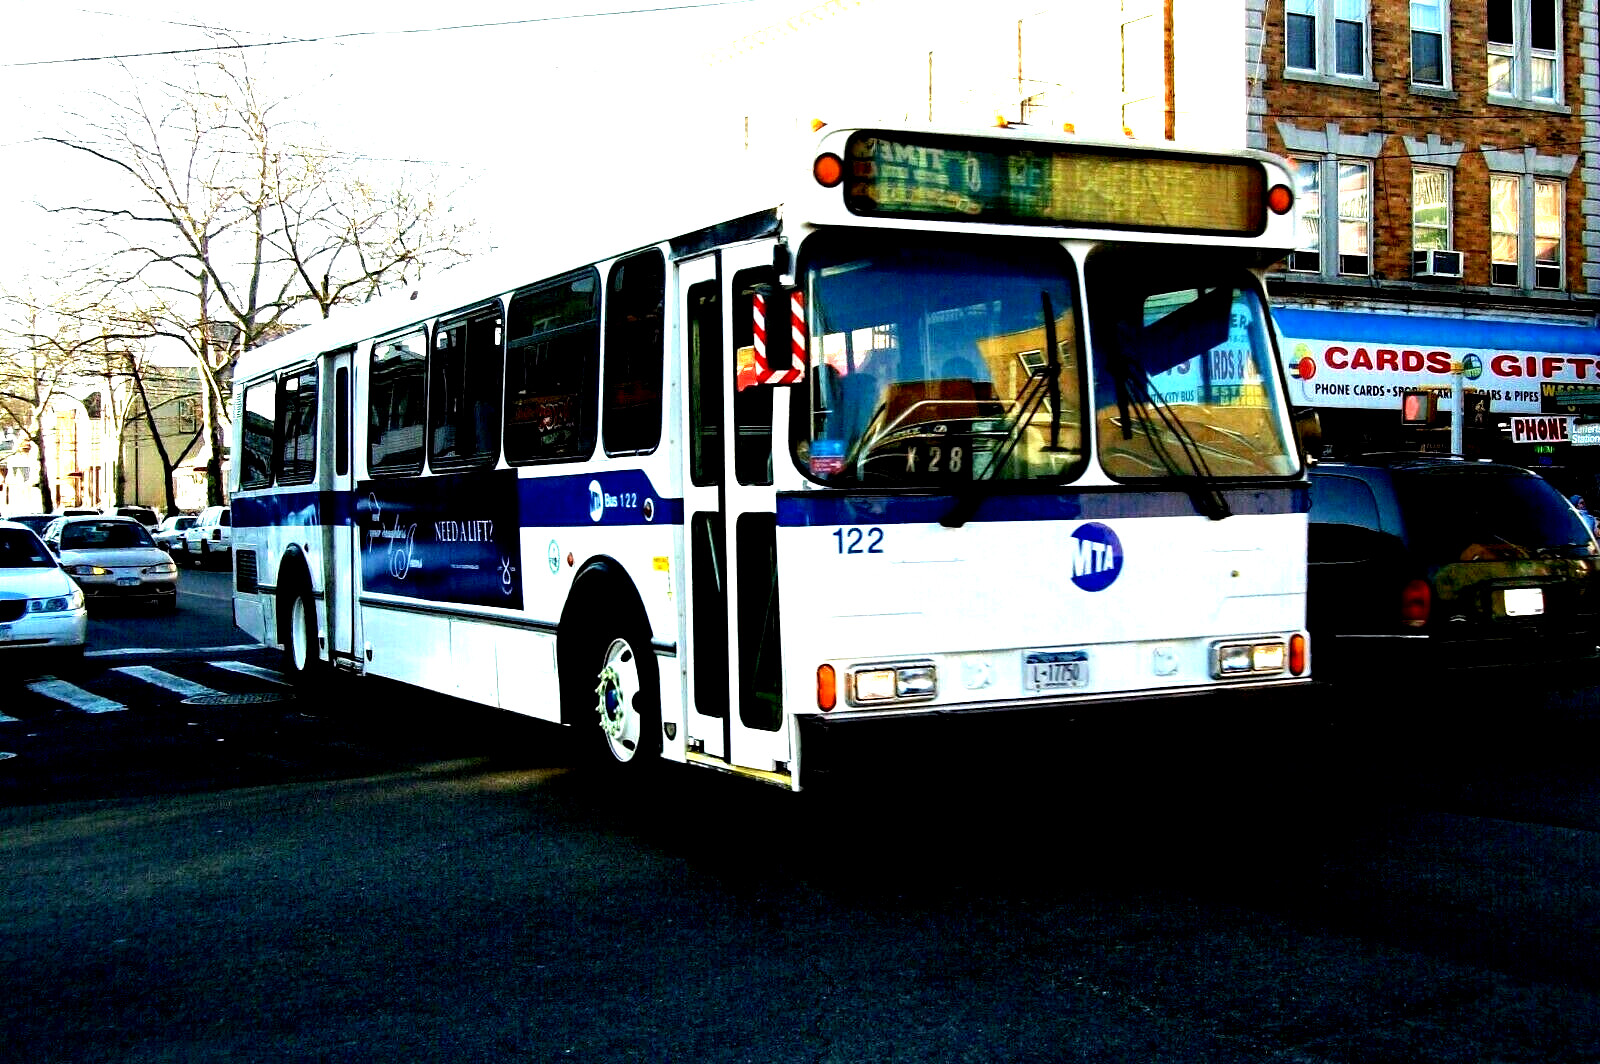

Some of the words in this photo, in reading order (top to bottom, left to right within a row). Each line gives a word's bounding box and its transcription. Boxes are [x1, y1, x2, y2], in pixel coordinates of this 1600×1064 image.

[1324, 346, 1452, 374] CARDS
[1490, 355, 1600, 379] GIFT
[1180, 390, 1194, 402] BUS
[1315, 384, 1350, 395] PHONE
[1353, 385, 1385, 396] CARDS
[1505, 391, 1511, 401] &
[1515, 391, 1538, 402] PIPES
[1514, 418, 1568, 441] PHONE
[620, 493, 637, 508] 122
[434, 520, 458, 541] NEED
[460, 520, 467, 541] A
[468, 520, 493, 542] LIFT?
[832, 527, 884, 554] 122
[1070, 536, 1115, 577] MTA
